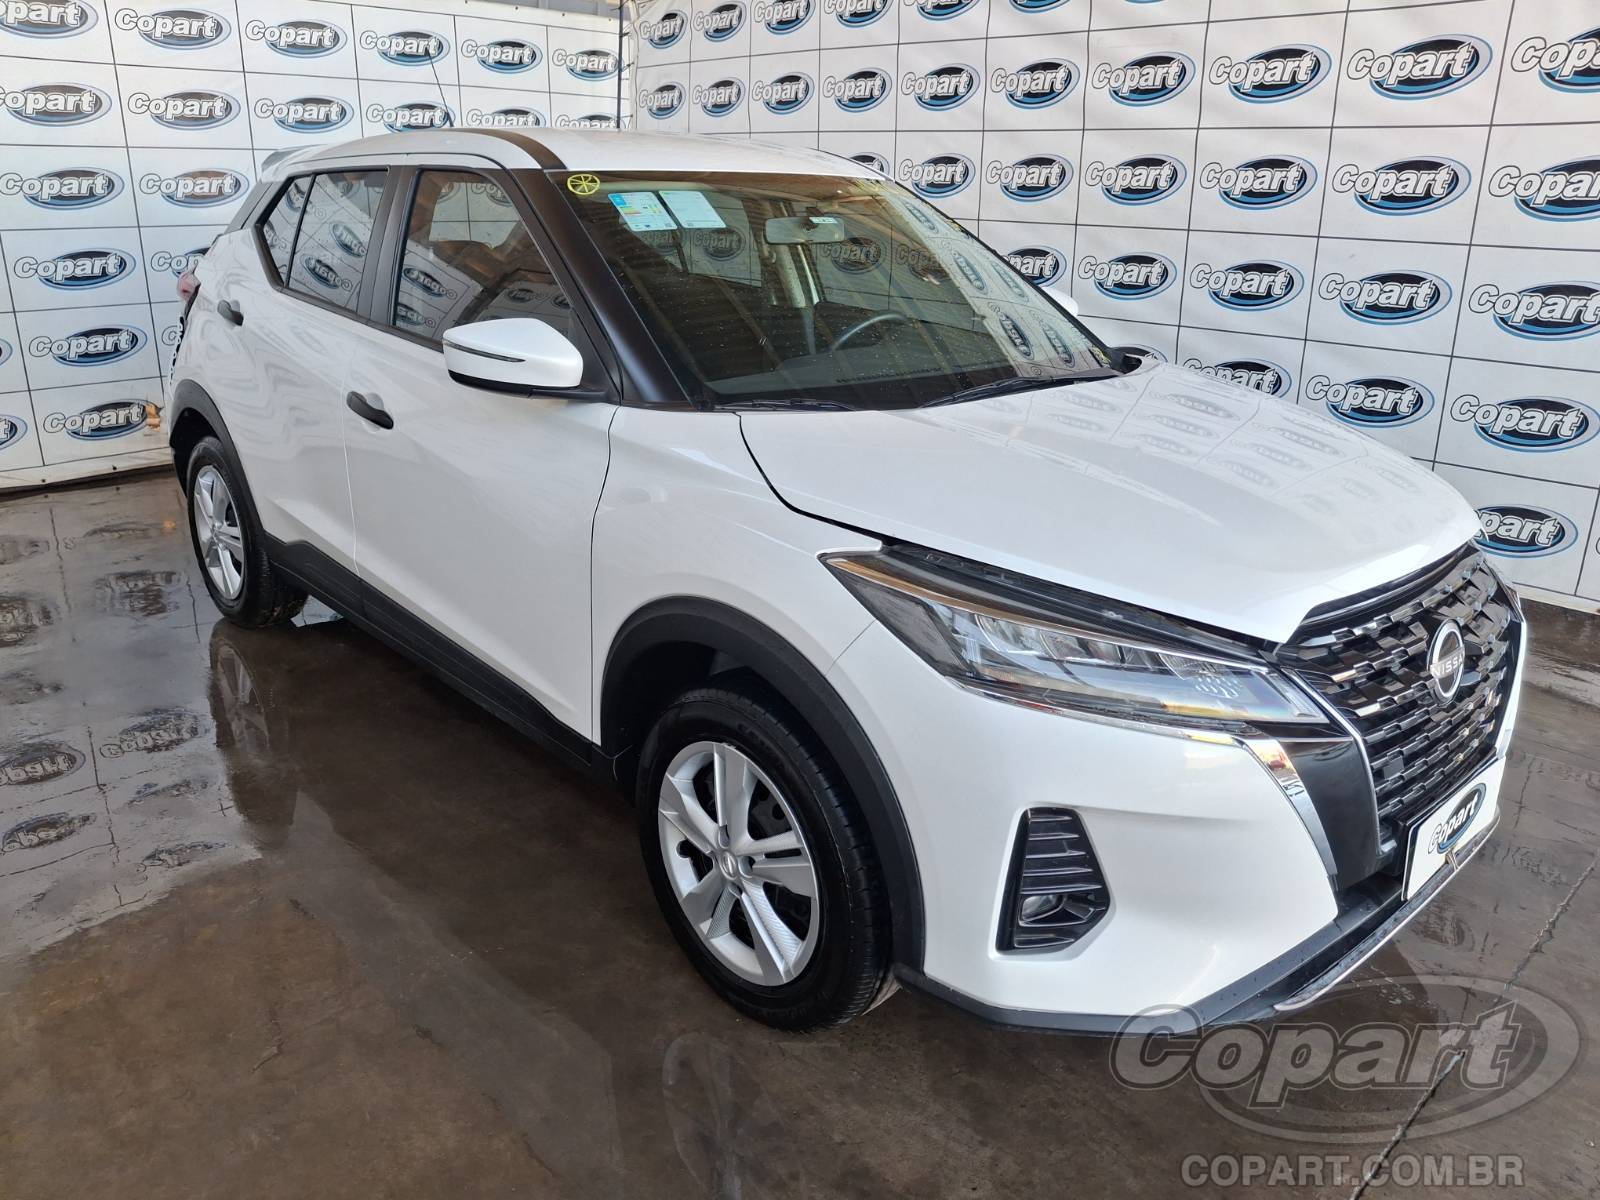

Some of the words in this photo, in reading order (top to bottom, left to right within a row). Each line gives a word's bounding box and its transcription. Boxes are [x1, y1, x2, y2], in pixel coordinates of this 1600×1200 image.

[0, 0, 81, 26] part
[115, 8, 216, 38] Copart
[693, 6, 740, 35] Copart
[754, 0, 806, 26] Copart
[246, 20, 335, 49] Copart
[360, 30, 440, 56] Copart
[461, 40, 532, 65] Copart
[552, 49, 617, 73] Copart
[1347, 41, 1475, 87] Copart
[1511, 36, 1600, 80] Cop
[901, 69, 971, 99] Copart
[991, 64, 1071, 99] Copart
[1092, 58, 1185, 96] Copart
[1209, 51, 1319, 92] Copart
[0, 84, 96, 116] opart
[639, 86, 680, 112] Copart
[693, 82, 739, 110] Copart
[752, 76, 806, 105] Copart
[823, 73, 886, 102] Copart
[128, 92, 227, 121] Copart
[254, 98, 342, 124] Copart
[366, 104, 446, 127] Copart
[0, 172, 109, 200] Copart
[139, 173, 235, 198] Copart
[899, 158, 966, 188] Copart
[986, 160, 1064, 190] Copart
[1085, 161, 1176, 195] Copart
[1200, 160, 1305, 197] Copart
[1332, 164, 1454, 203] Copart
[1488, 165, 1600, 207] Copa
[14, 252, 122, 281] Copart
[151, 251, 202, 273] Cop
[1001, 253, 1056, 278] part
[1078, 255, 1166, 288] Copart
[1190, 263, 1291, 298] Copart
[1318, 273, 1439, 310] Copart
[1469, 284, 1600, 326] Copart
[29, 330, 132, 359] Copart
[1306, 375, 1418, 414] Copart
[43, 403, 144, 434] Copart
[1450, 394, 1584, 438] Copart
[1474, 509, 1559, 547] part
[1428, 791, 1479, 854] Copart
